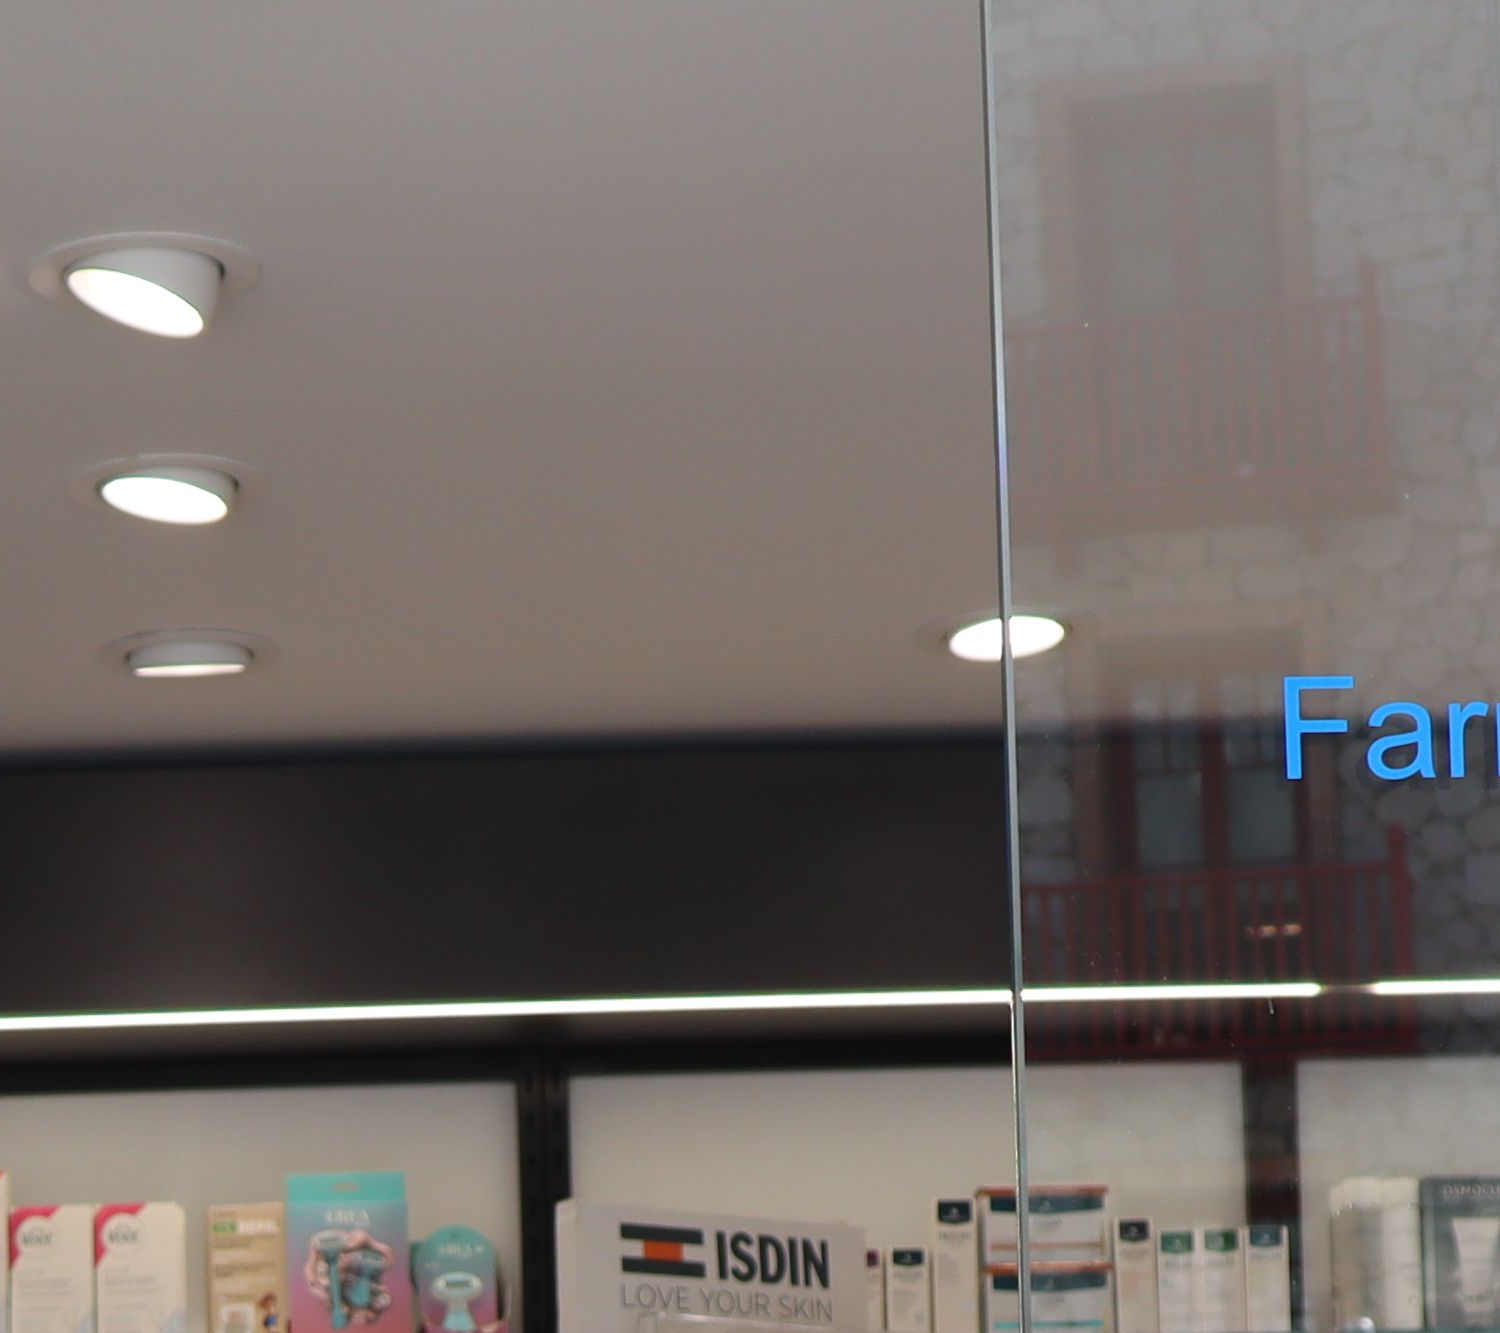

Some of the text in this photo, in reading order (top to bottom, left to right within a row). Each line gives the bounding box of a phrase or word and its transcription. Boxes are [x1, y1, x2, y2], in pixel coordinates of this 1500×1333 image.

[715, 1229, 831, 1290] ISDIN
[620, 1282, 833, 1323] LOVE YOUR SKIN
